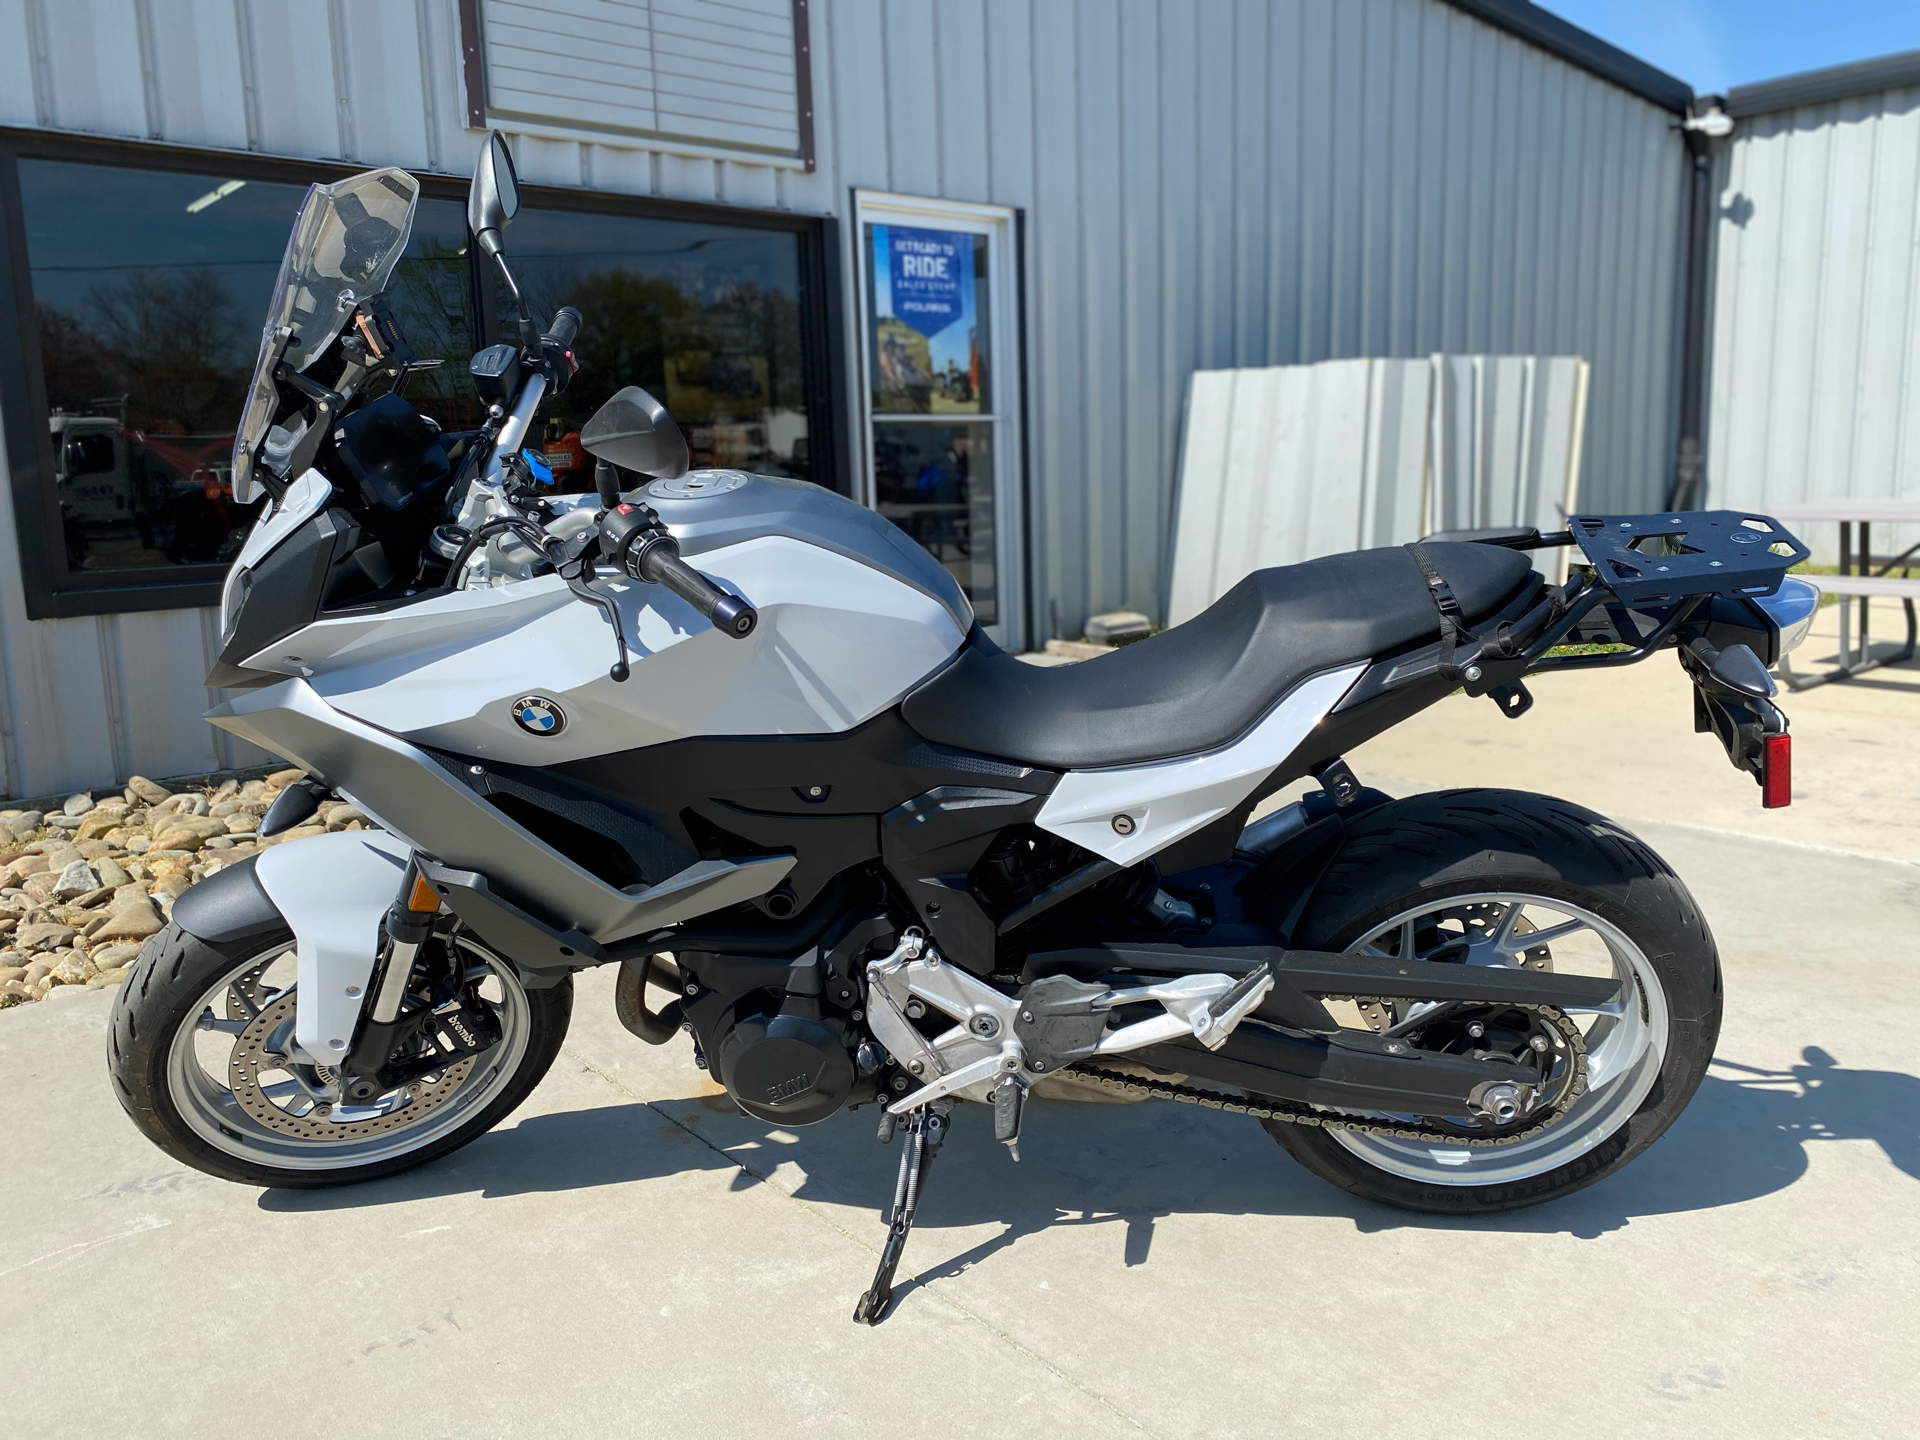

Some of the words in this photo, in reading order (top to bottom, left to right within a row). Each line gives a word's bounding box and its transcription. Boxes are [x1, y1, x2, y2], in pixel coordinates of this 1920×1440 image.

[903, 254, 949, 279] RIDE
[903, 301, 951, 313] POLARIS
[513, 699, 551, 717] BMW
[447, 1014, 477, 1047] brembo
[765, 1073, 811, 1100] BMW
[1484, 1138, 1622, 1203] MICHELIN
